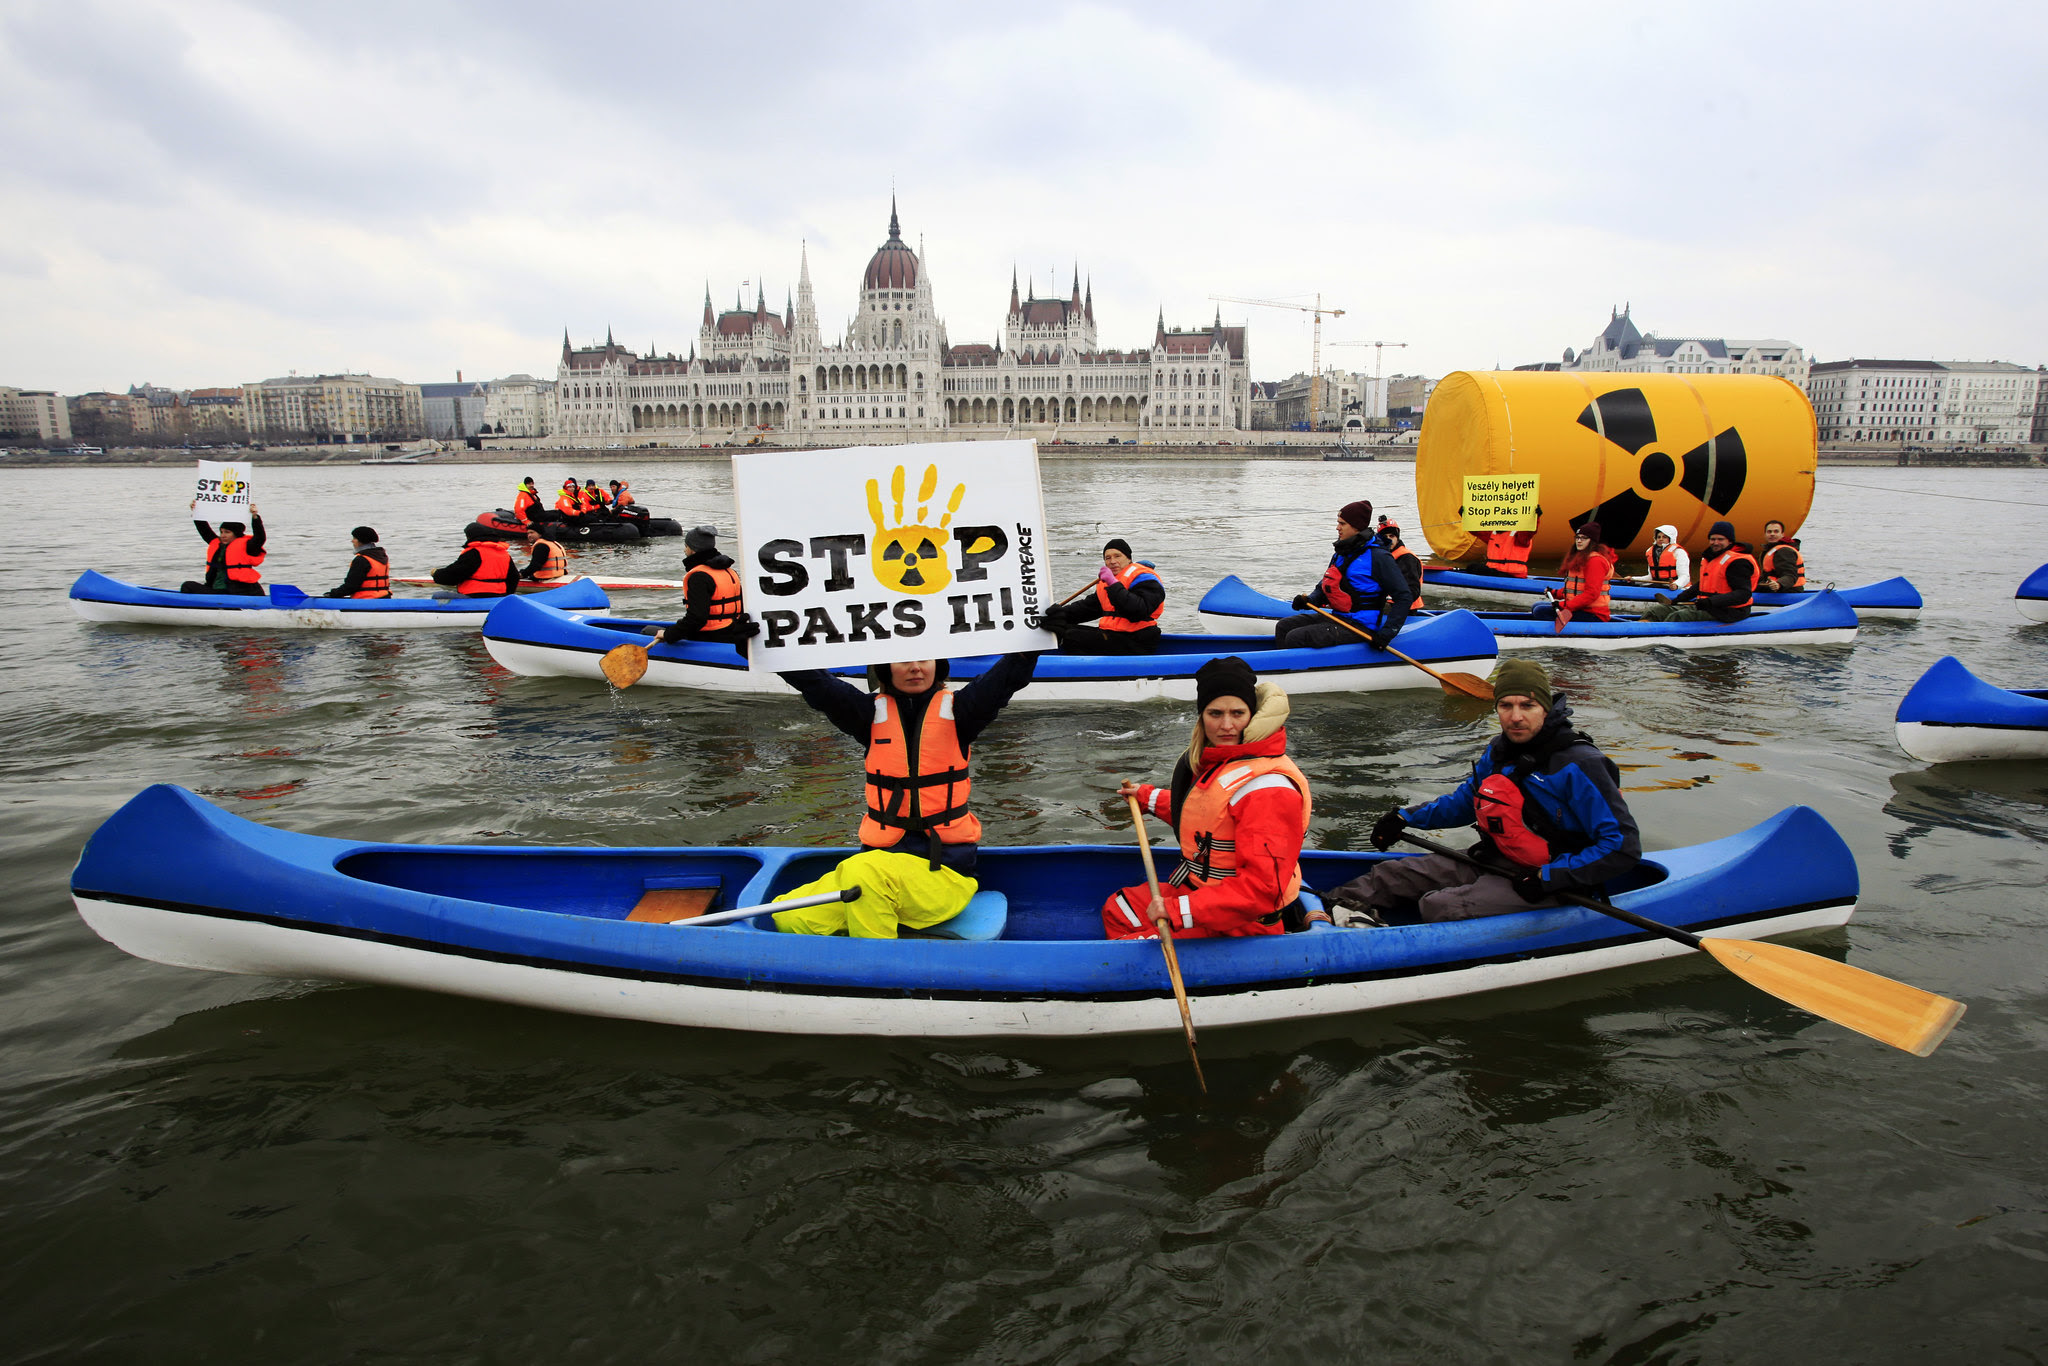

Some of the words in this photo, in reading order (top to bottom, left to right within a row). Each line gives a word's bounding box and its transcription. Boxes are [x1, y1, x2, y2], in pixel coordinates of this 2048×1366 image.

[1467, 481, 1500, 492] Veszély
[1502, 480, 1535, 491] helyett
[195, 492, 228, 503] PAKS
[231, 495, 245, 504] II!
[1471, 492, 1528, 503] biztonságot!
[1468, 506, 1491, 517] Stop
[1493, 506, 1518, 515] Paks
[1016, 522, 1040, 630] GREENPEACE
[761, 599, 926, 648] PAKS
[947, 587, 1015, 635] II!
